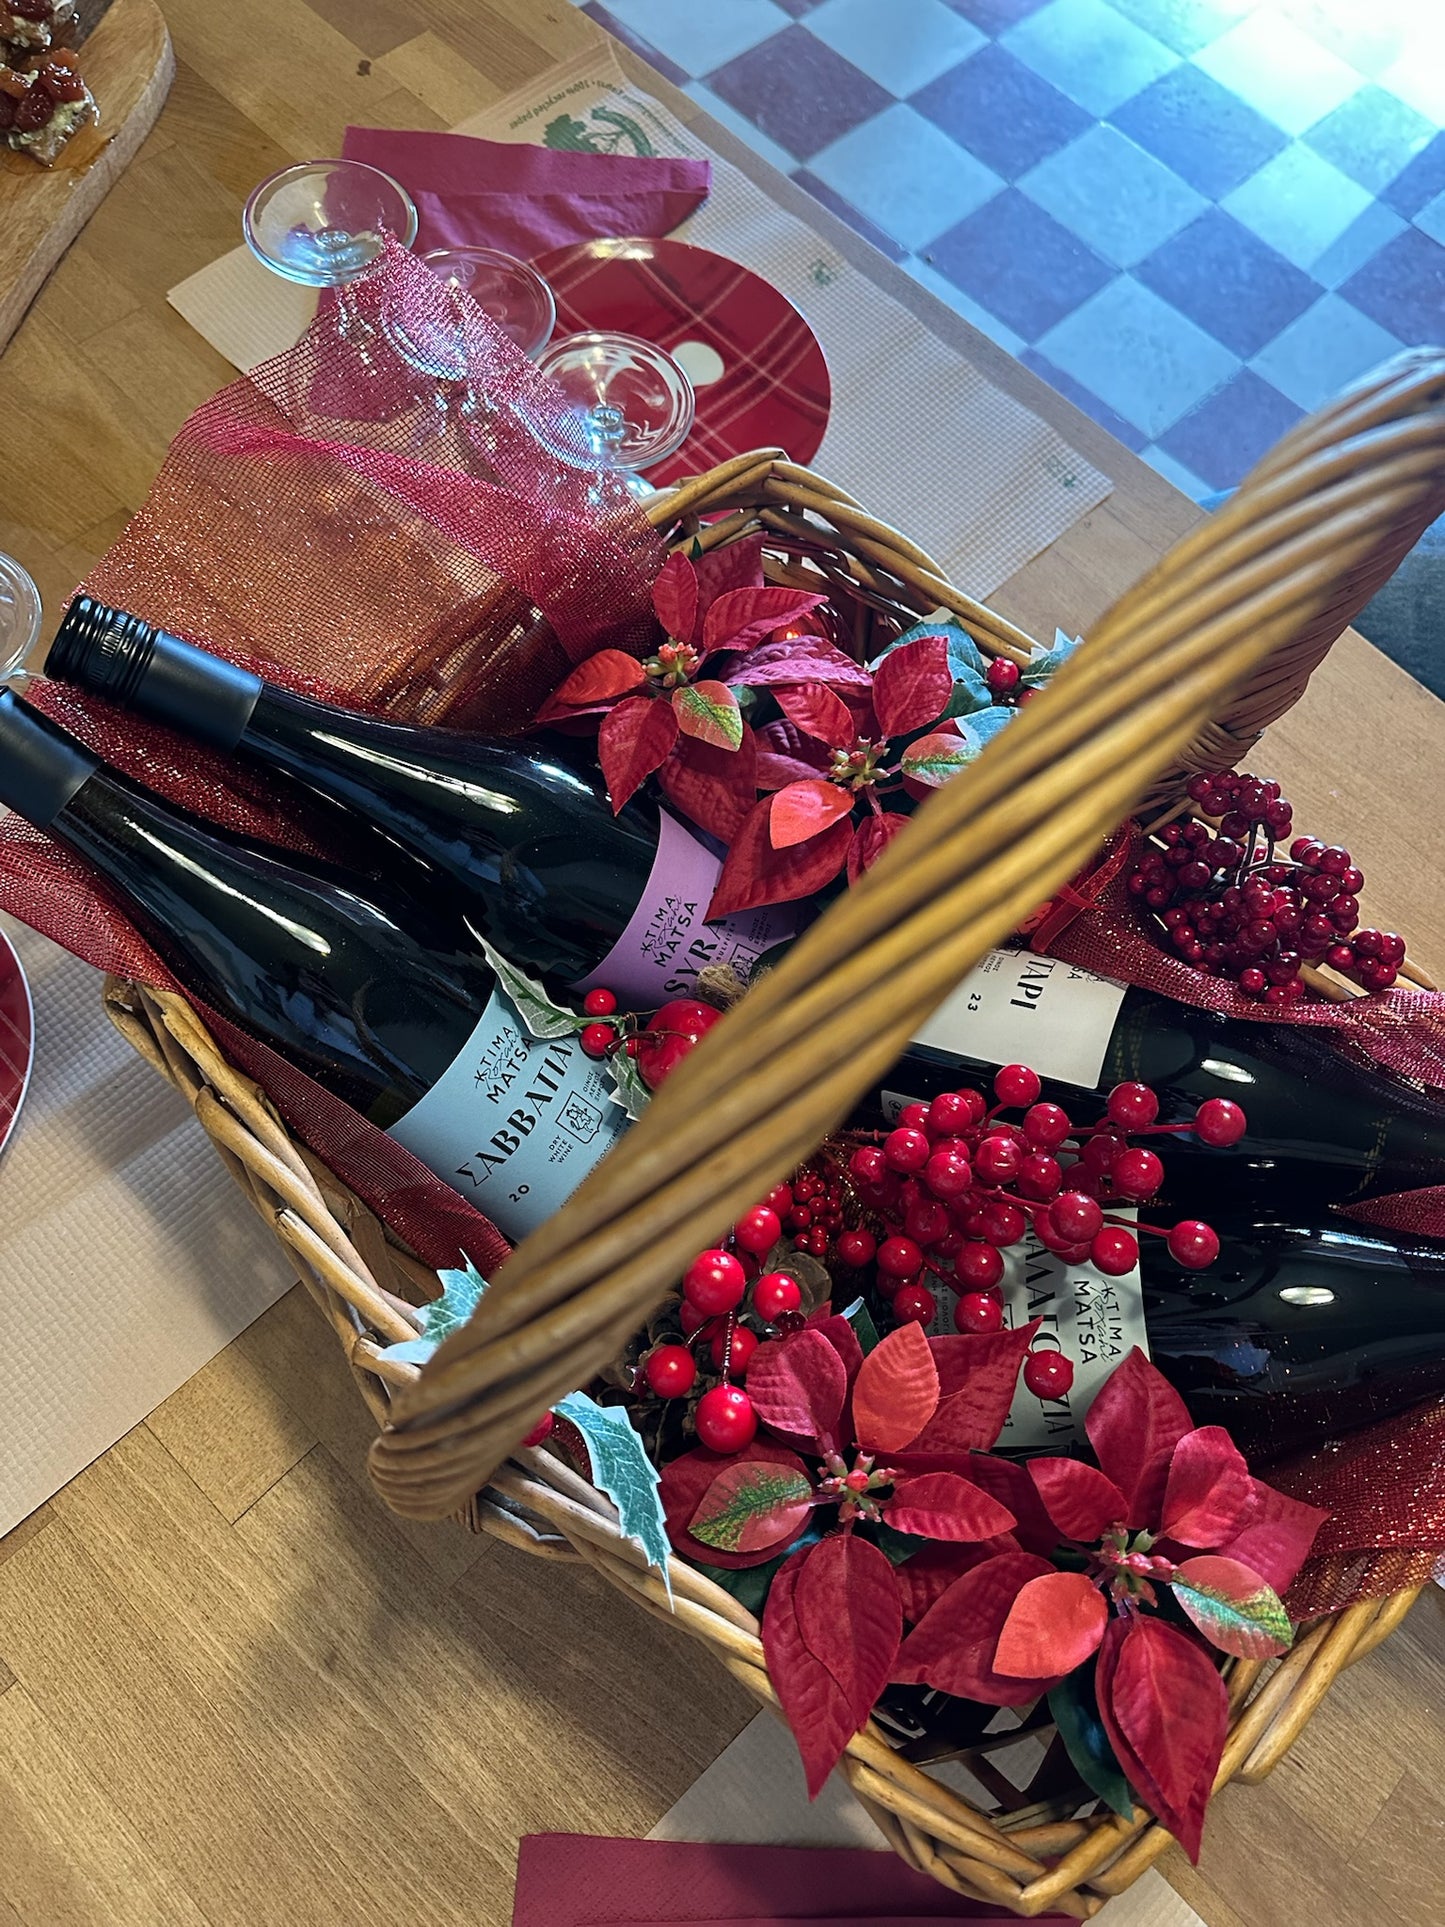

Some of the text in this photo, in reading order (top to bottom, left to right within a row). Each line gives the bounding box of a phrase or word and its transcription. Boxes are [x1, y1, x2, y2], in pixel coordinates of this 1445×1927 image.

[508, 79, 590, 130] 100% recycled paper
[640, 896, 676, 952] KTIMA
[654, 902, 698, 967] MATSA
[663, 888, 727, 996] SYRA
[967, 992, 982, 1012] 23
[474, 1026, 513, 1082] KTIMA
[486, 1037, 535, 1104] MATSA
[455, 1038, 574, 1187] ΣΑΒΒΑΤΙΑ
[548, 1134, 562, 1150] DRY
[548, 1138, 569, 1164] WHITE
[557, 1142, 575, 1164] WINE
[508, 1184, 530, 1203] 20
[1074, 1280, 1097, 1364] MATSA
[1101, 1286, 1122, 1357] KTIMA
